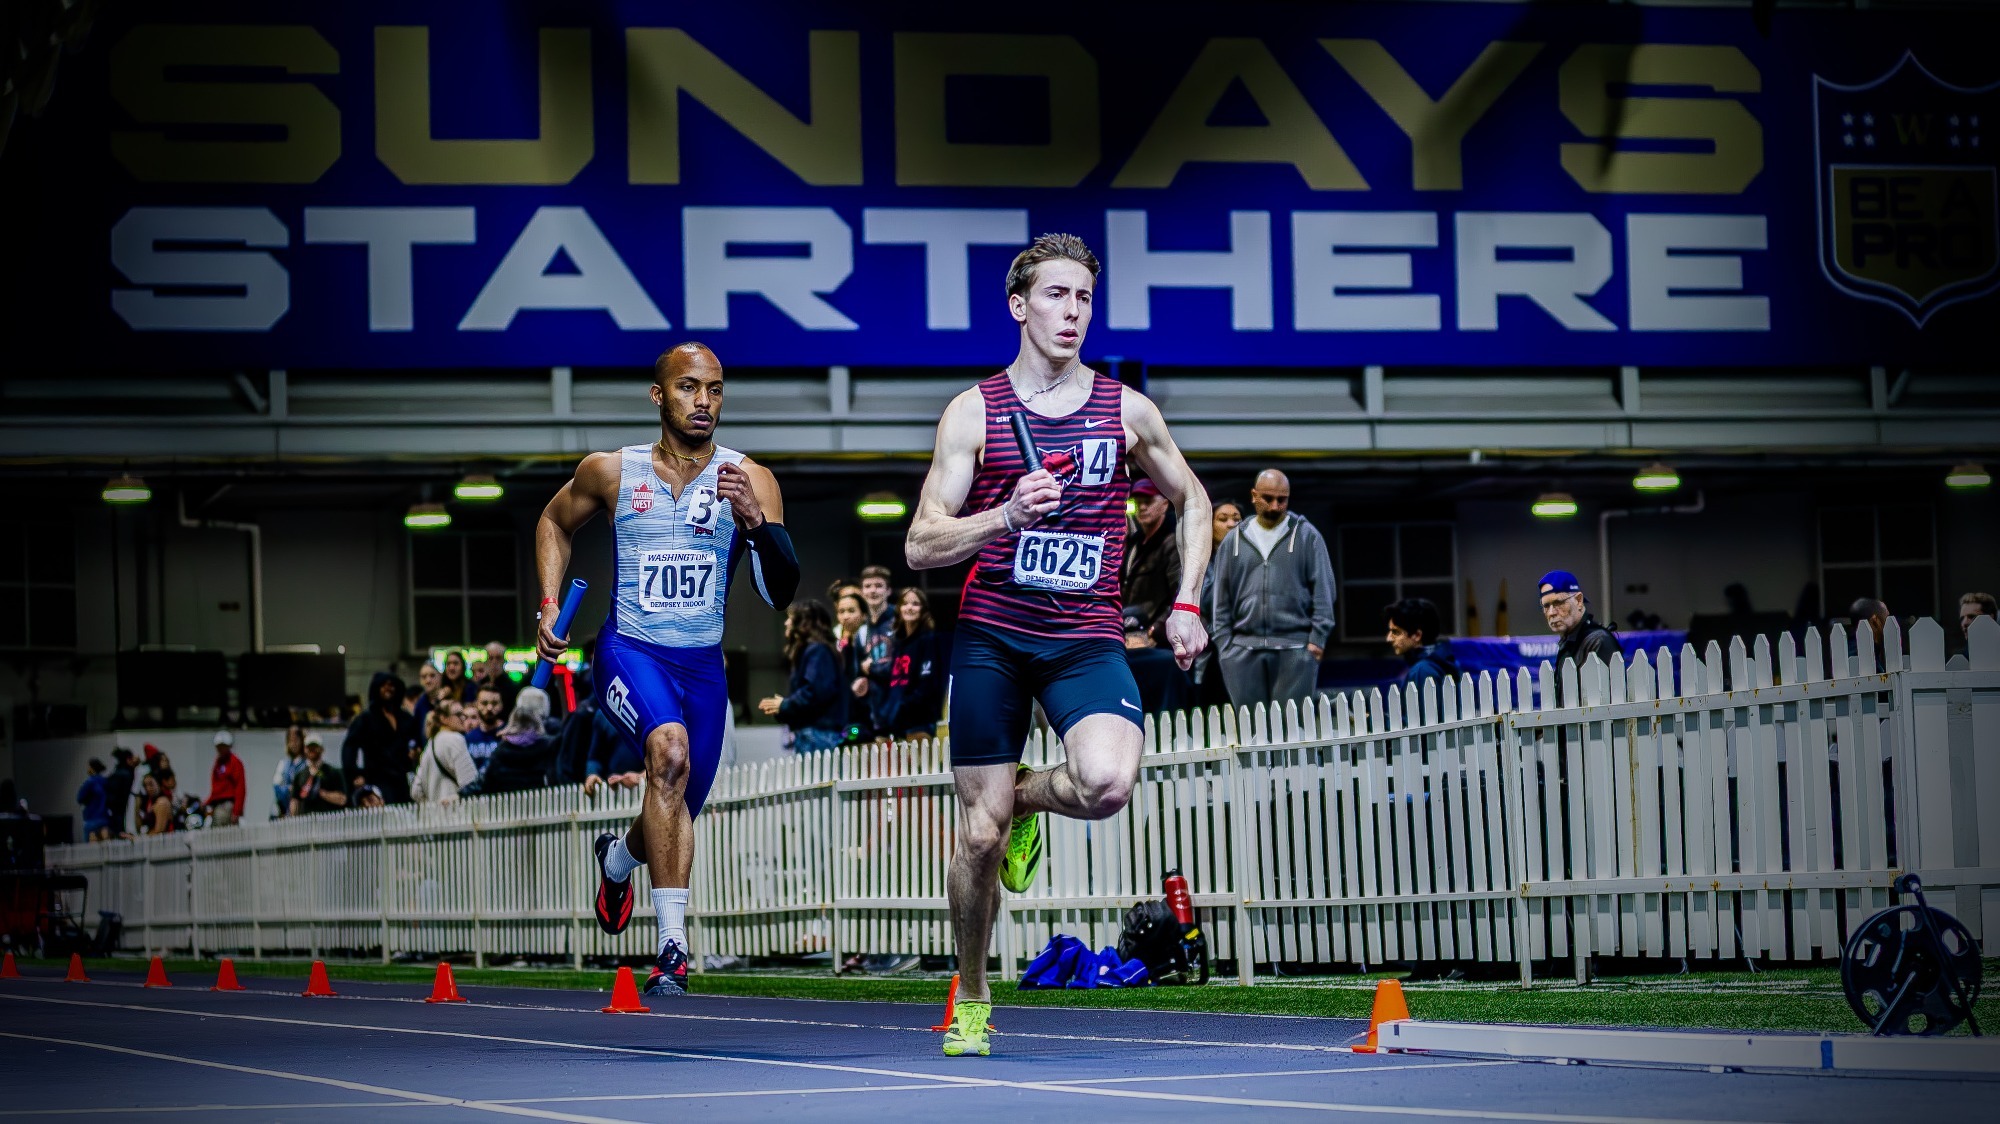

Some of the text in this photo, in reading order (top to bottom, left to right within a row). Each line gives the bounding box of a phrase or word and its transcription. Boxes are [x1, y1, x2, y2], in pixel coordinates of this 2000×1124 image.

[110, 24, 1764, 194] SUNDAYS
[1851, 177, 1980, 220] BE A
[1853, 223, 1983, 269] PRO
[111, 207, 1770, 331] START HERE
[1088, 441, 1110, 483] 4
[633, 499, 652, 509] WEST
[691, 488, 716, 525] 3
[648, 553, 708, 562] WASHINGTON
[1021, 536, 1099, 580] 6625
[643, 564, 713, 600] 7057
[1025, 574, 1088, 589] DEMPSEY INDOOR
[682, 600, 706, 608] INDOOR
